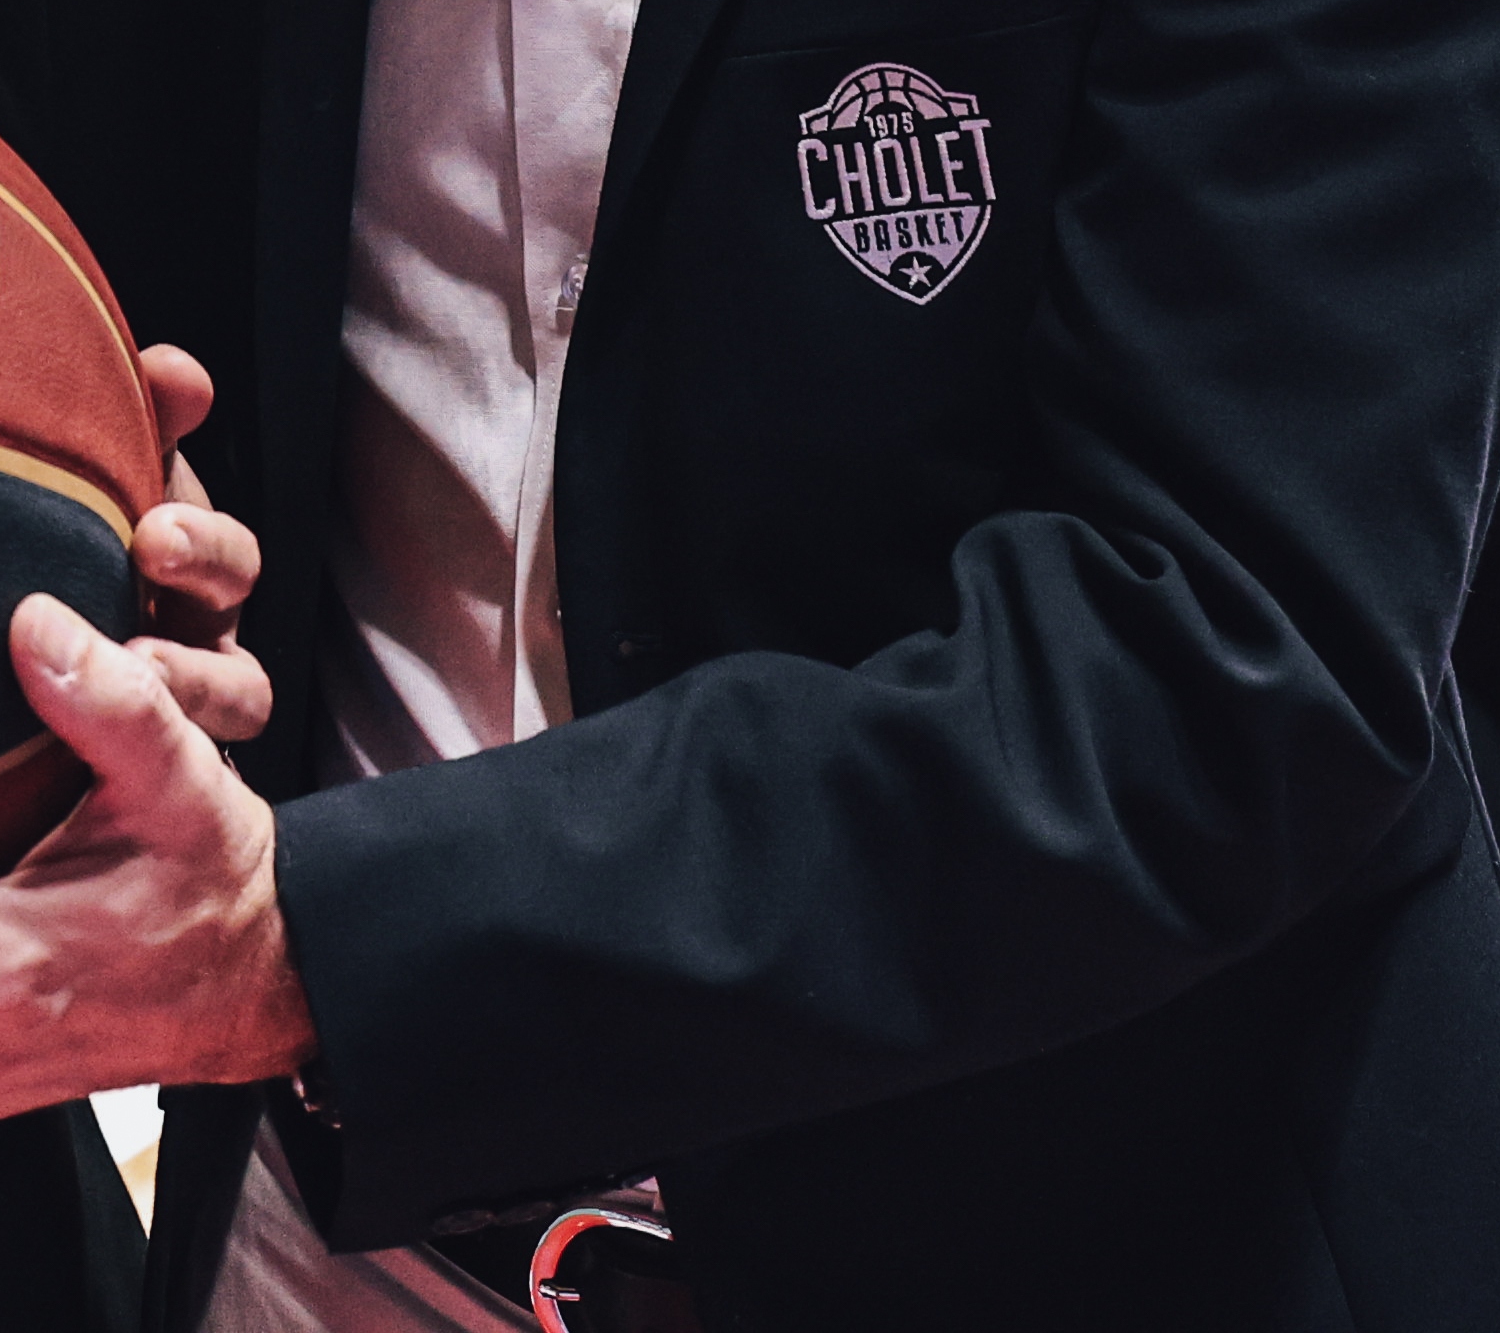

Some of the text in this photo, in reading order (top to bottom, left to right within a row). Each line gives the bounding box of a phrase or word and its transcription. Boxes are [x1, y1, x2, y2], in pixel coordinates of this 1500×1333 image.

[863, 111, 915, 139] 1975
[796, 118, 996, 221] CHOLET
[854, 209, 966, 254] BASKET
